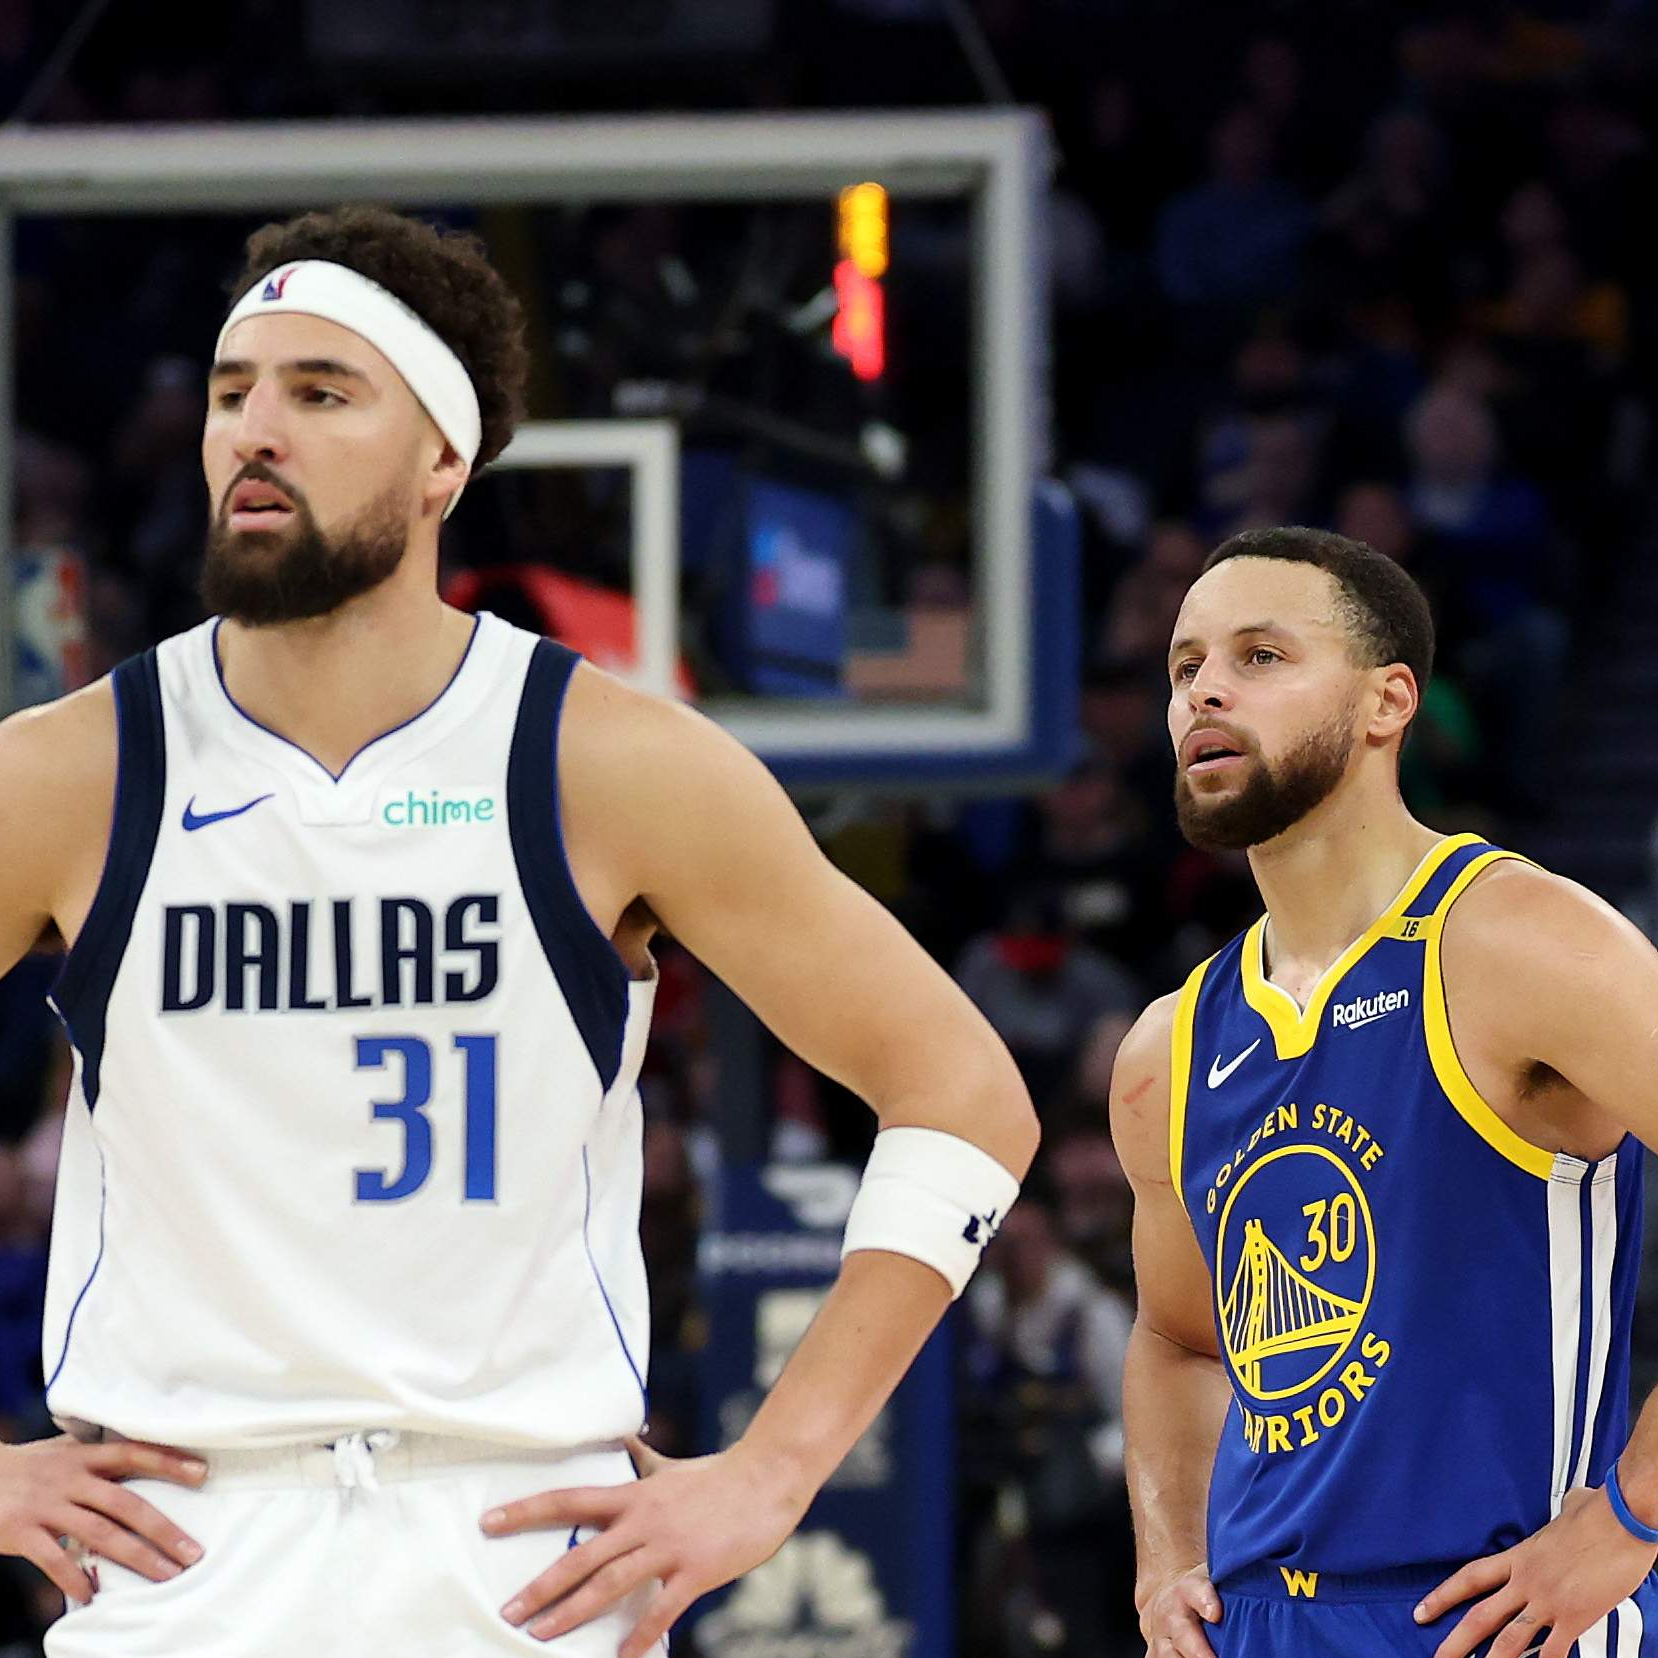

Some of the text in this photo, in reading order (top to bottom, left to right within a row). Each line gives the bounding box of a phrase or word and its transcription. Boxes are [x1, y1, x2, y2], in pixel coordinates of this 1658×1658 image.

[384, 790, 494, 825] chime
[159, 894, 500, 1015] DALLAS
[1332, 988, 1410, 1029] Rakuten
[352, 1033, 500, 1206] 31
[1207, 1102, 1385, 1215] GOLDEN STATE
[1299, 1192, 1357, 1263] 30
[1243, 1331, 1391, 1454] ARRIORS
[1279, 1566, 1319, 1598] W
